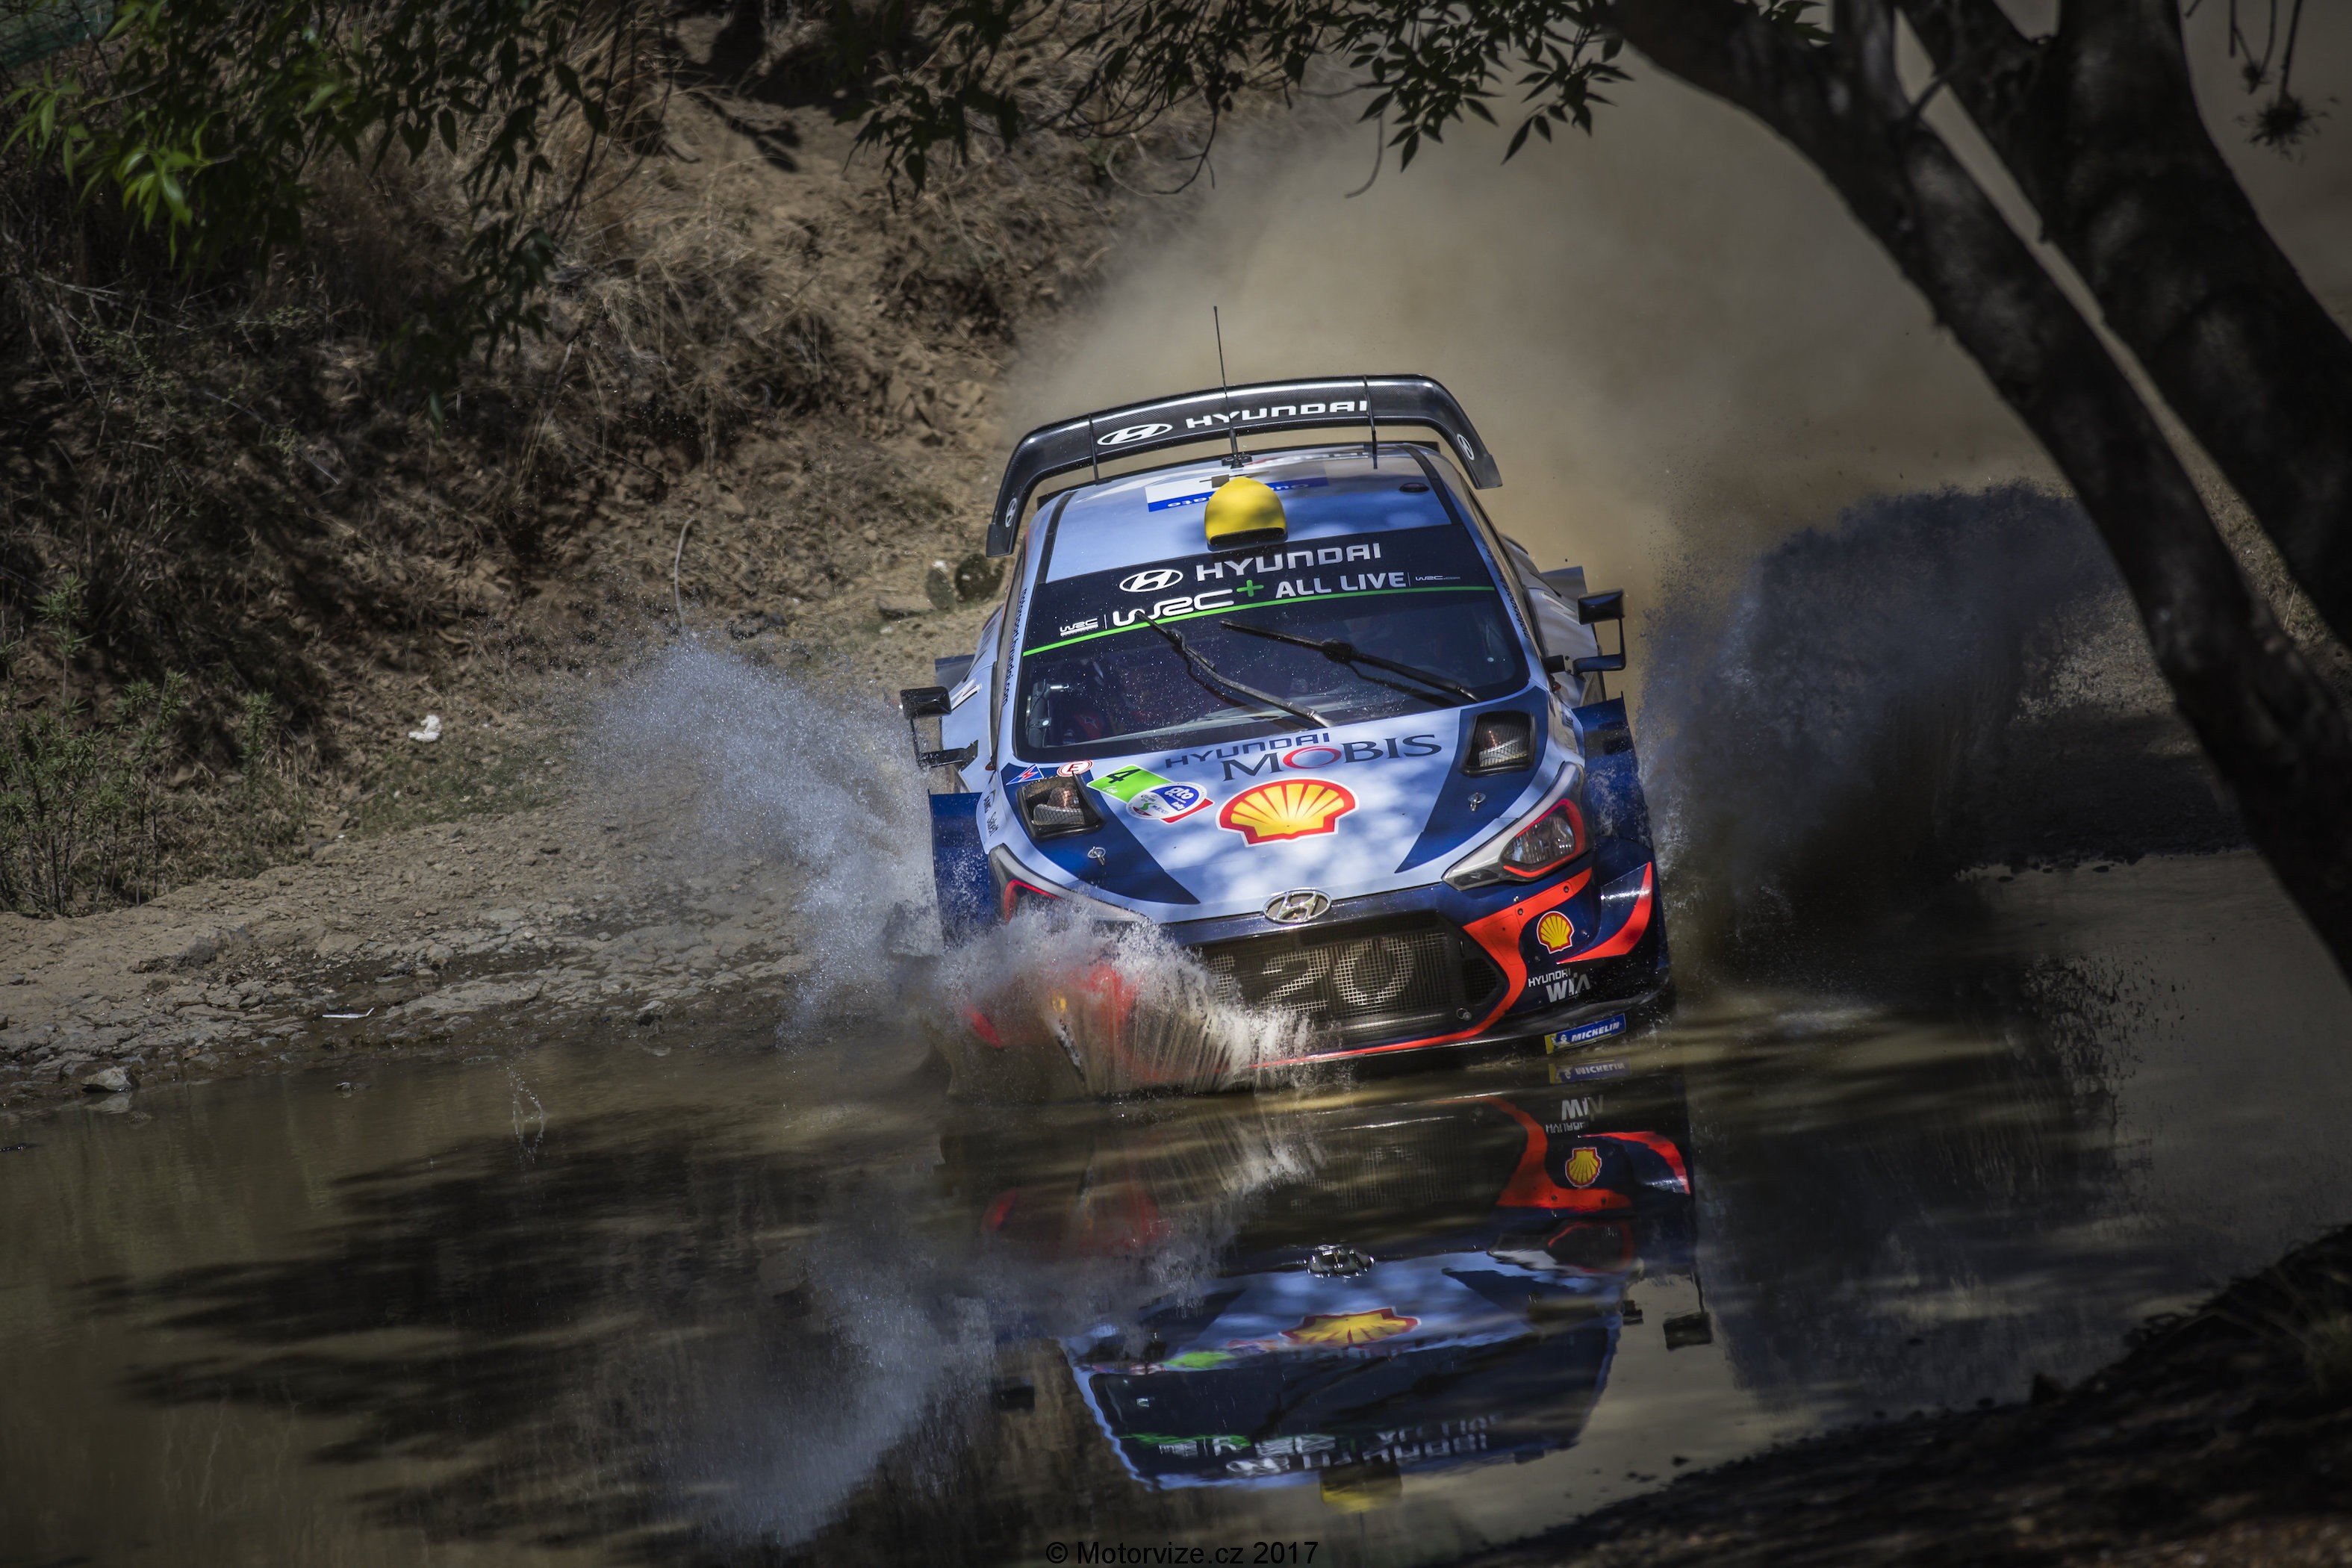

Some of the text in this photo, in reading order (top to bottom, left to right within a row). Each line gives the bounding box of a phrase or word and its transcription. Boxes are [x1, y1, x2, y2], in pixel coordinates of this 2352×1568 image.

[1186, 400, 1368, 429] HYUNDAI
[1196, 542, 1381, 582] HYUNDAI
[1275, 578, 1332, 599] ALL
[1340, 571, 1407, 591] LIVE
[1003, 588, 1027, 707] motorsport.hyundai.com
[1165, 732, 1331, 768] HYUNDAI
[1220, 734, 1443, 782] MOBIS
[1107, 768, 1142, 784] 4
[1528, 968, 1571, 988] HYUNDAI
[1546, 972, 1591, 1003] WIA
[1571, 1021, 1620, 1042] MICHELIN
